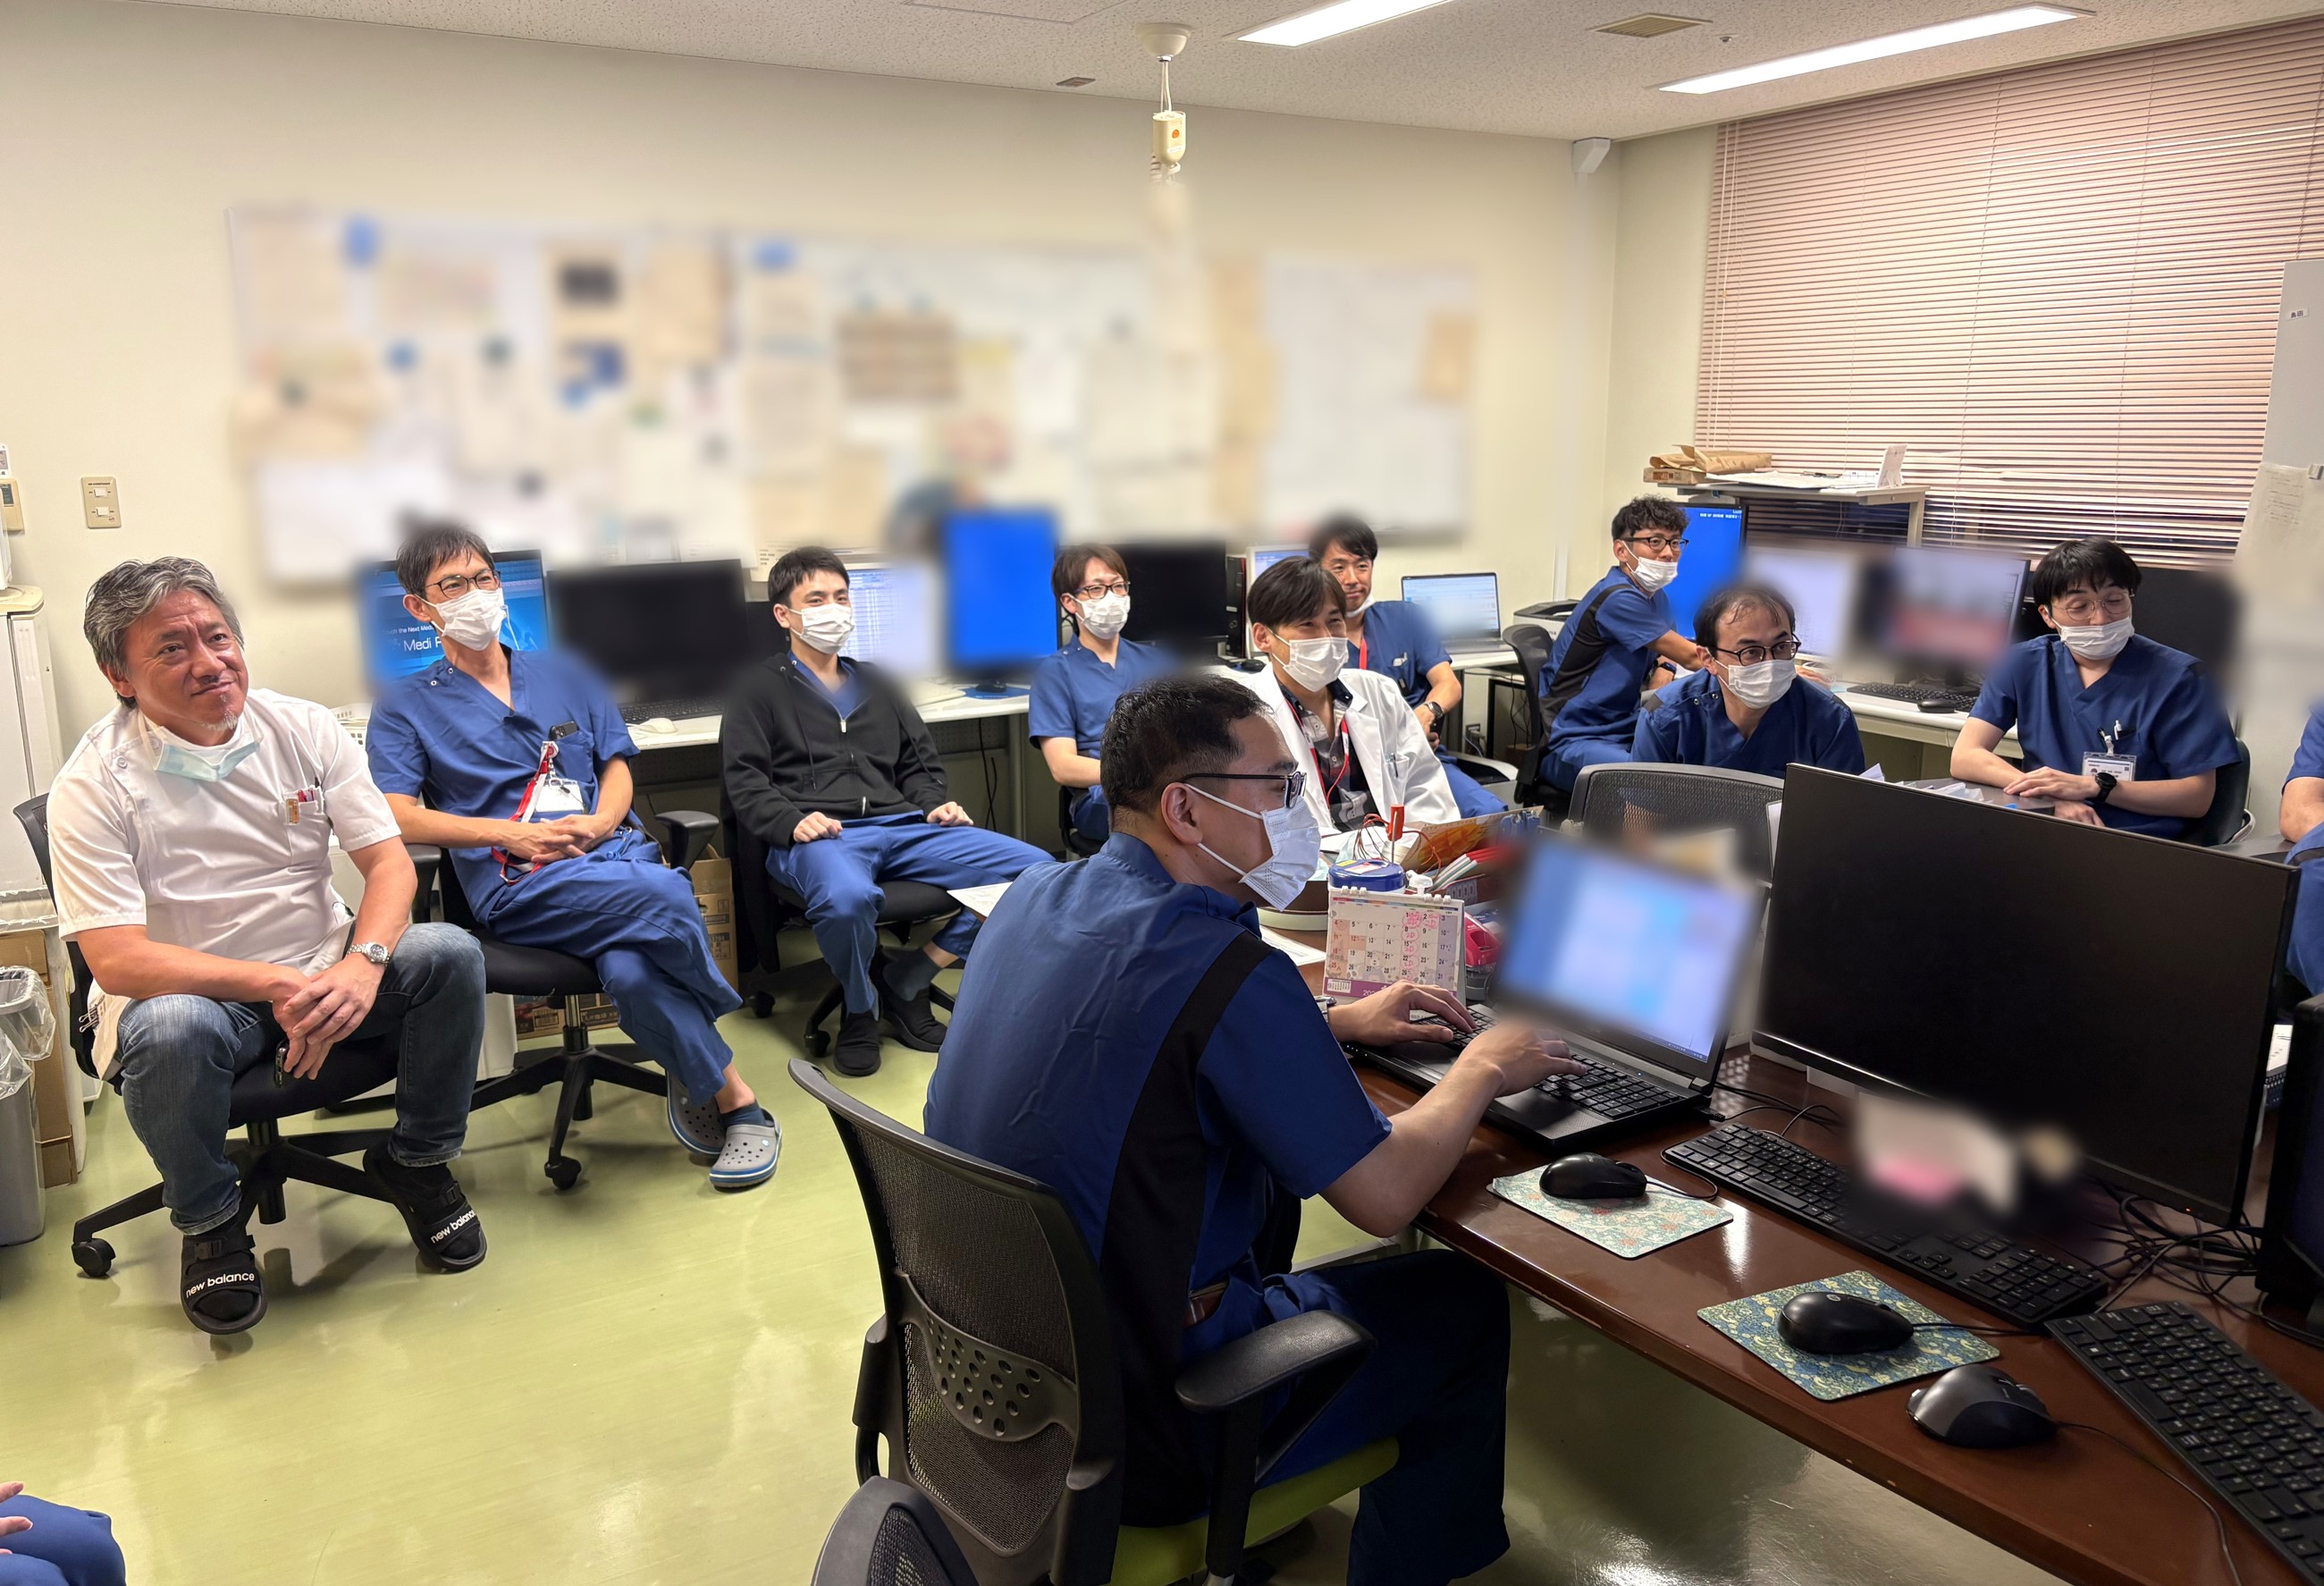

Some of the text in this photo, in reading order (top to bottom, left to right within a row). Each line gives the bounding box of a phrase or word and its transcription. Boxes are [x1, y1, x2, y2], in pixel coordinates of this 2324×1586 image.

[403, 637, 432, 652] Medi
[430, 1226, 450, 1244] new
[186, 1272, 255, 1298] new balance
